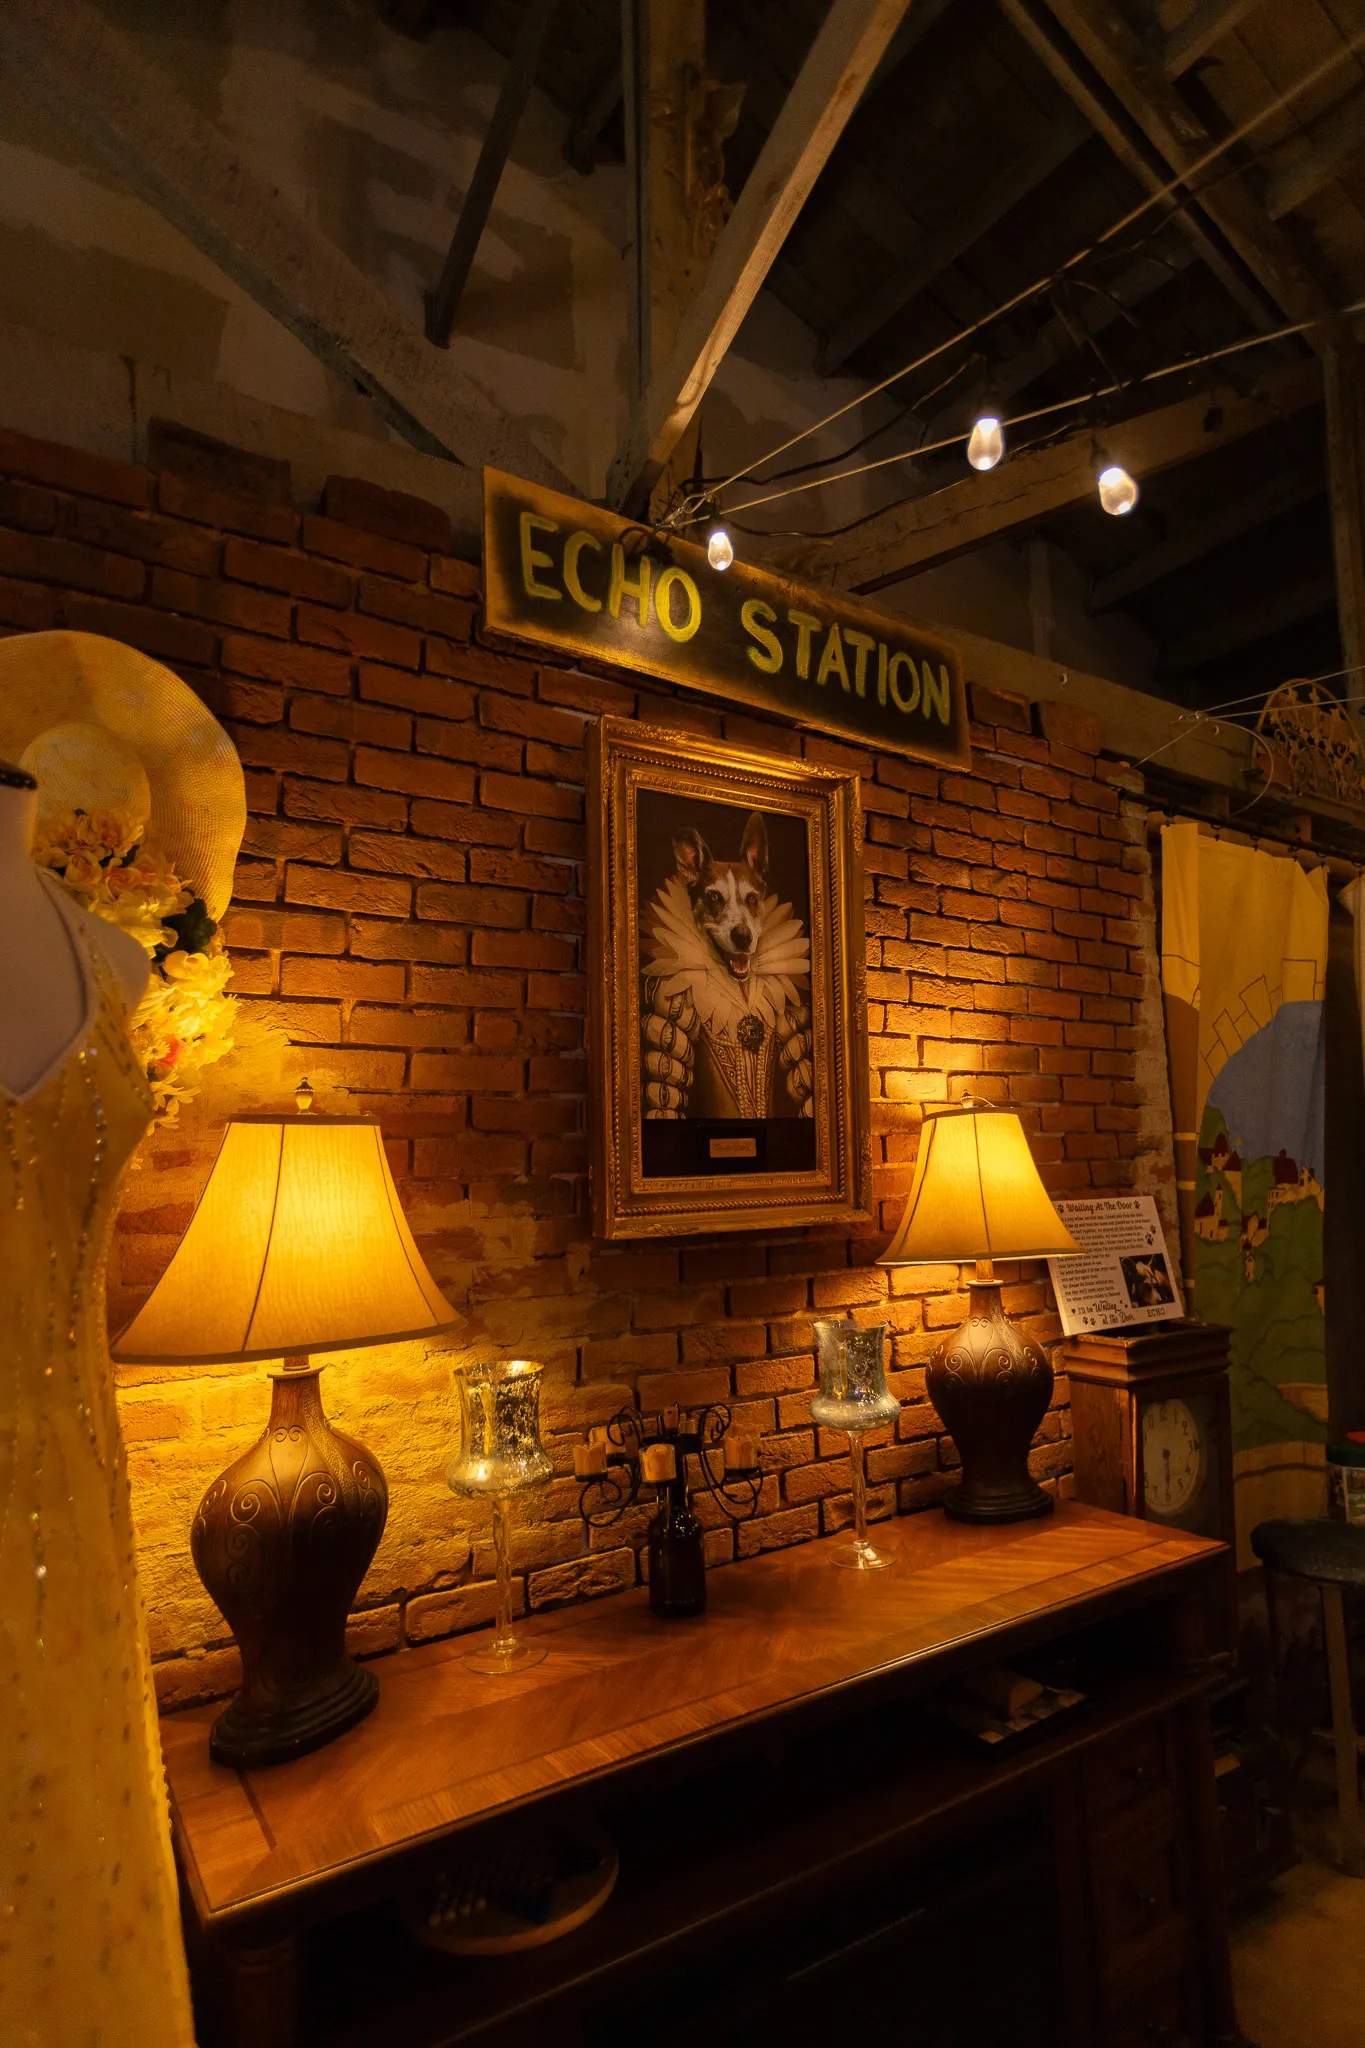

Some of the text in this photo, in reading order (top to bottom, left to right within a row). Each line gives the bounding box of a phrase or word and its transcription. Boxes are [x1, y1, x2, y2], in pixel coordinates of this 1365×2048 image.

[519, 512, 952, 726] ECHO STATION
[1066, 1200, 1132, 1215] Waiting At The Door
